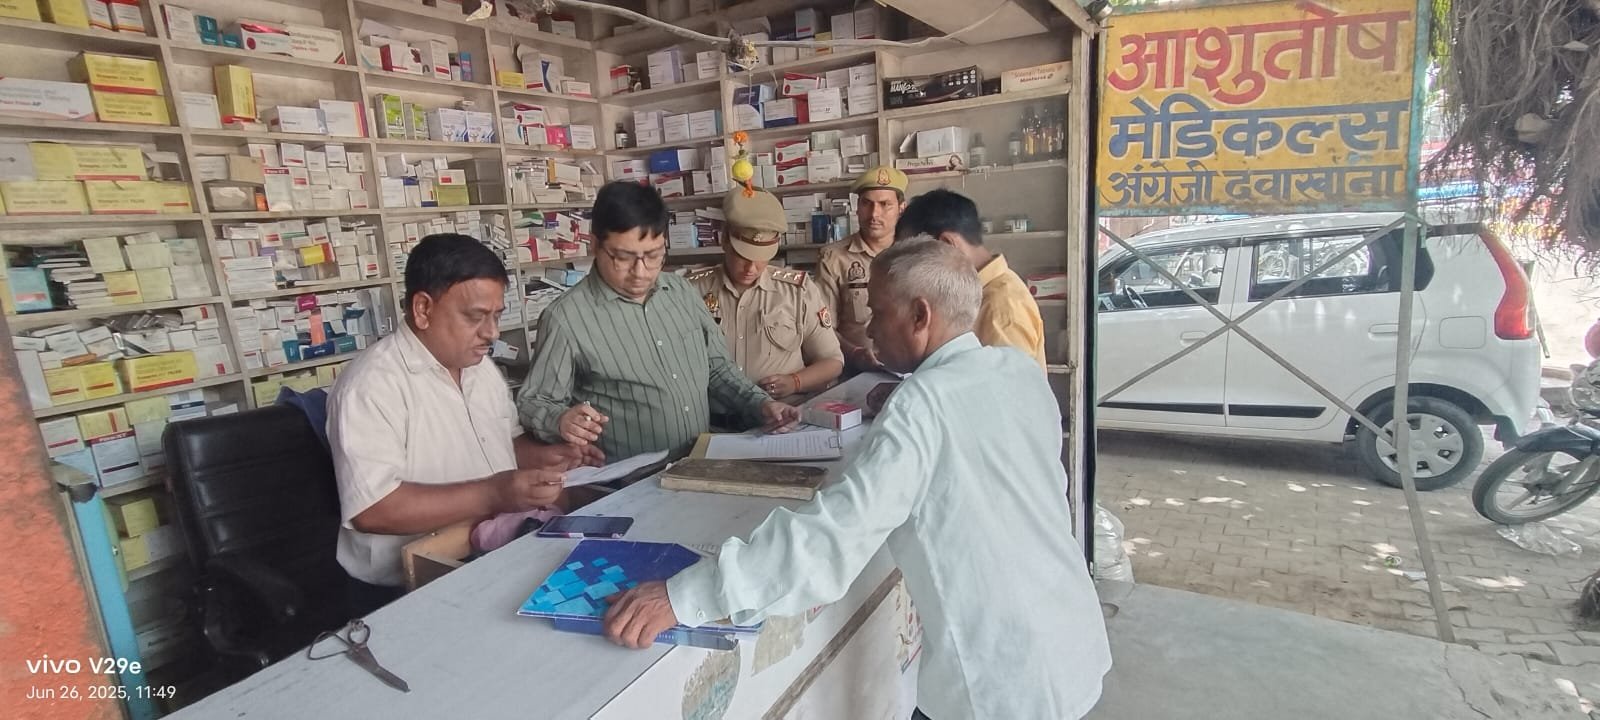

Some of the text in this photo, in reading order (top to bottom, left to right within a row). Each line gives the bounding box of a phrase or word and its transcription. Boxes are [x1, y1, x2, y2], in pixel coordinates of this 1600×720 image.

[1107, 1, 1411, 105] आशुतोष
[1109, 93, 1410, 159] मेडिकल्स
[1101, 160, 1403, 205] अंग्रेजी दवाखाना
